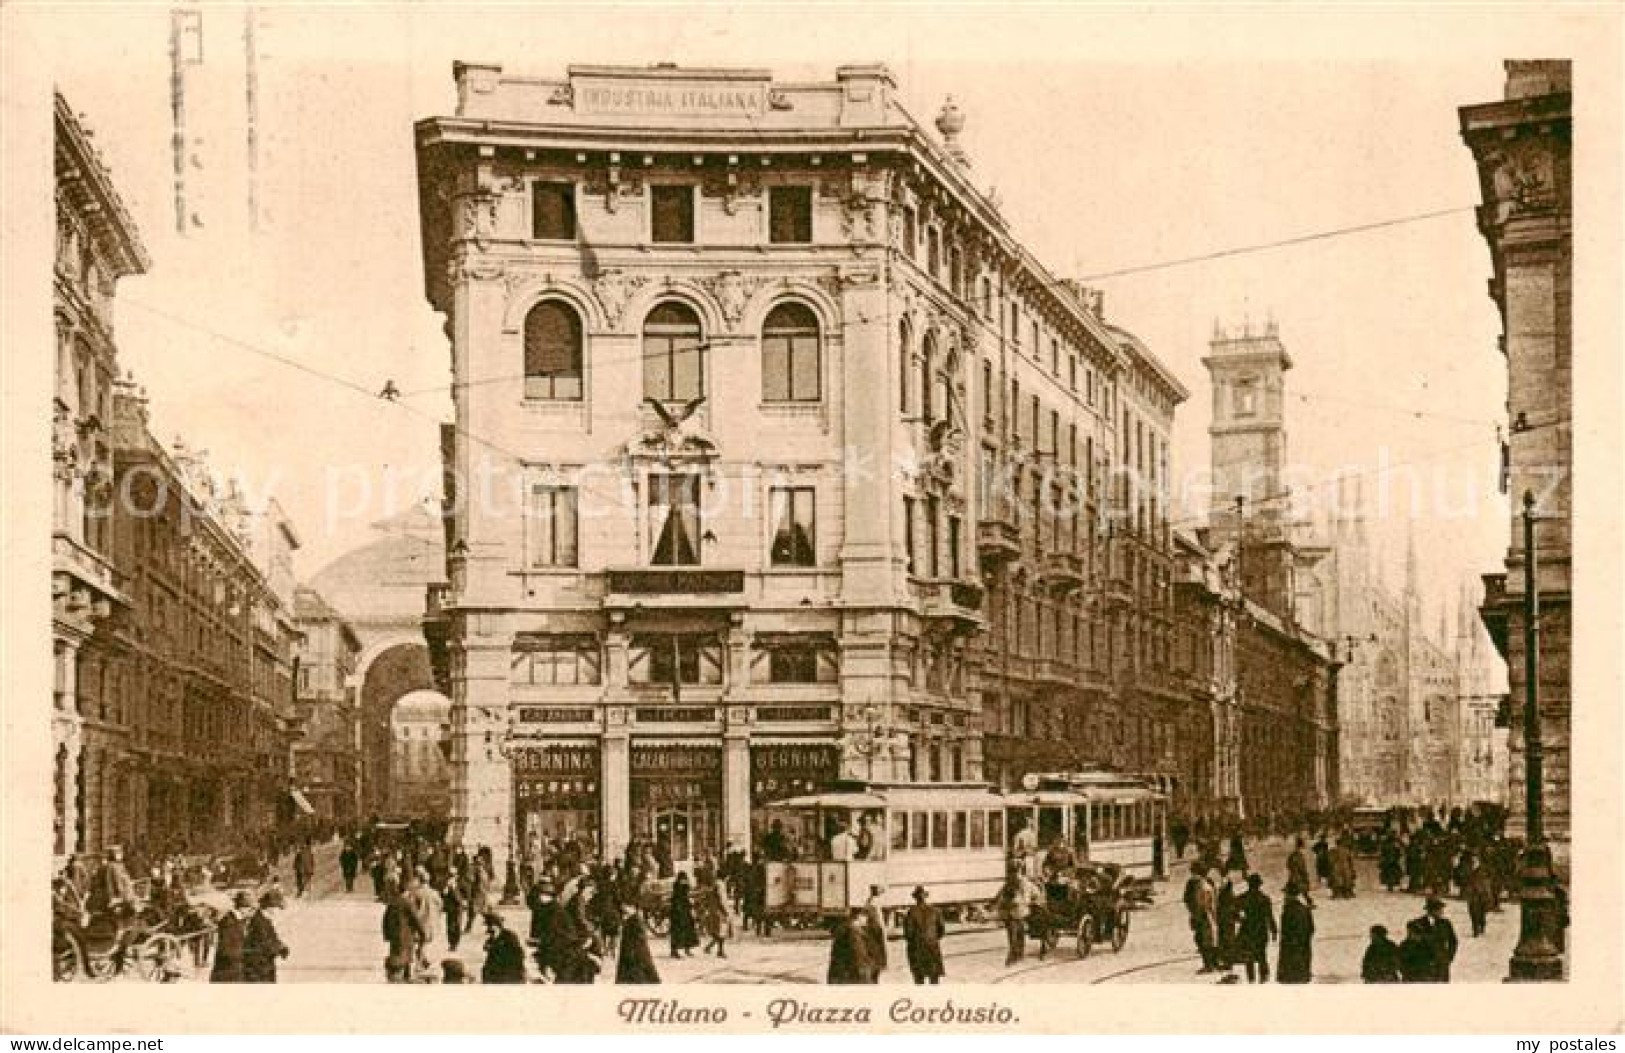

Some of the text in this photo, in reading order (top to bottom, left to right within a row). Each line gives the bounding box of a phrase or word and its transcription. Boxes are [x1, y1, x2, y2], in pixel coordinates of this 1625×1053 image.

[583, 89, 757, 108] INDUSTRIA ITALIANA
[517, 752, 593, 768] BERNINA
[756, 750, 832, 768] BERNINA
